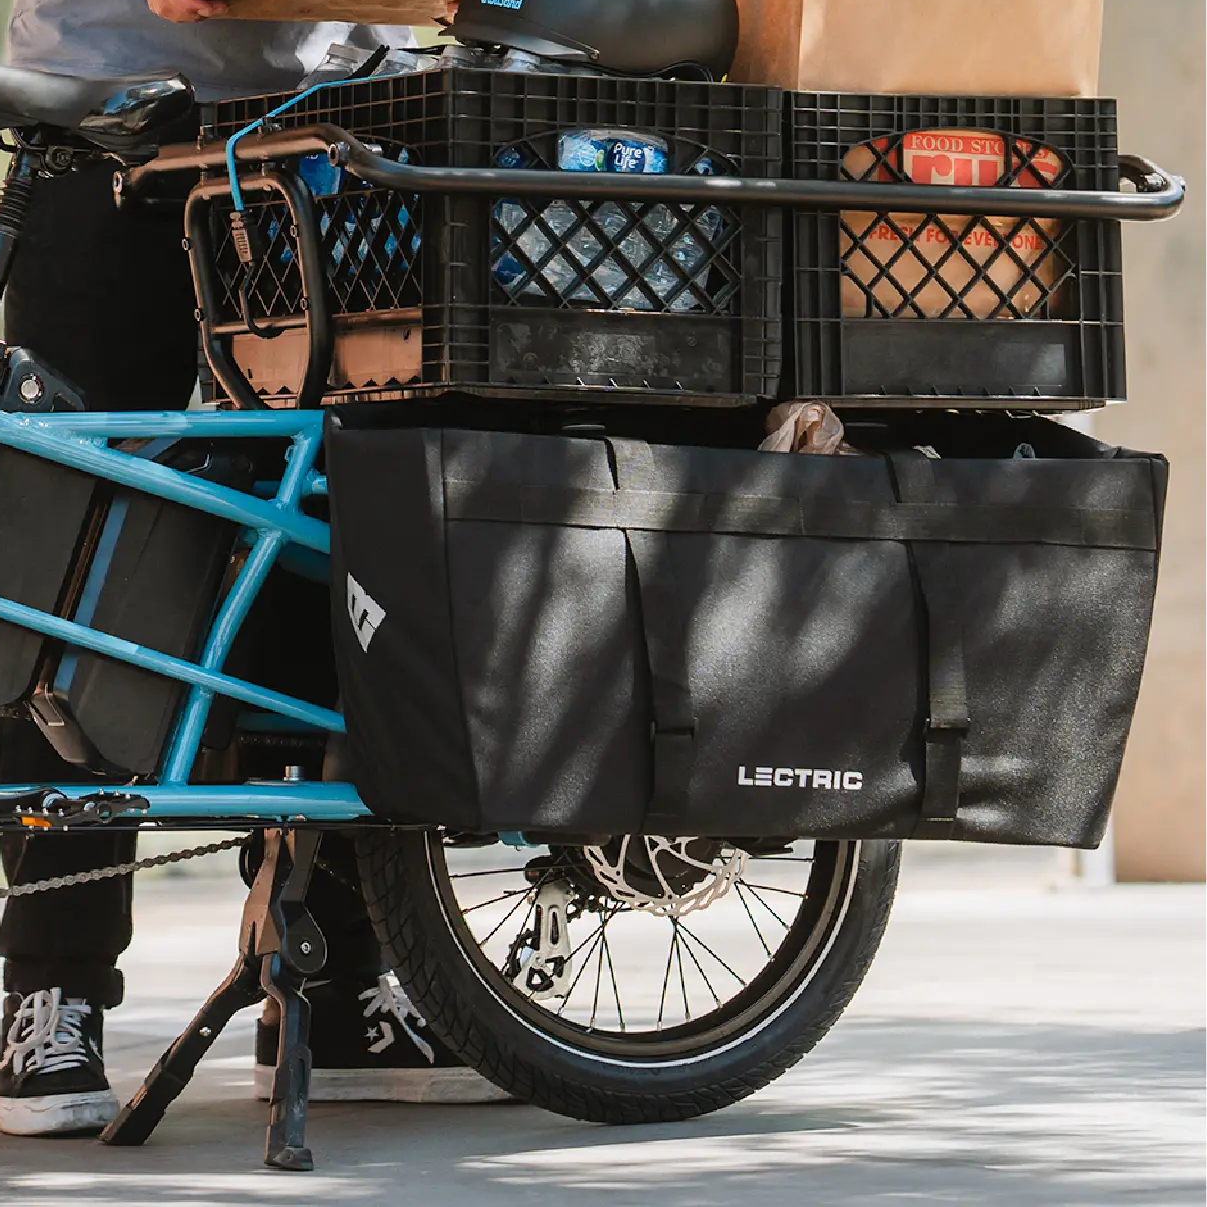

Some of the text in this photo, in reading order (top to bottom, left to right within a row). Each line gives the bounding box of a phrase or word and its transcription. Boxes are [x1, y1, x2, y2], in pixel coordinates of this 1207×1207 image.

[613, 143, 642, 159] Pure
[911, 135, 964, 153] FOOD
[615, 154, 638, 169] Life
[737, 765, 864, 791] LECTRIC
